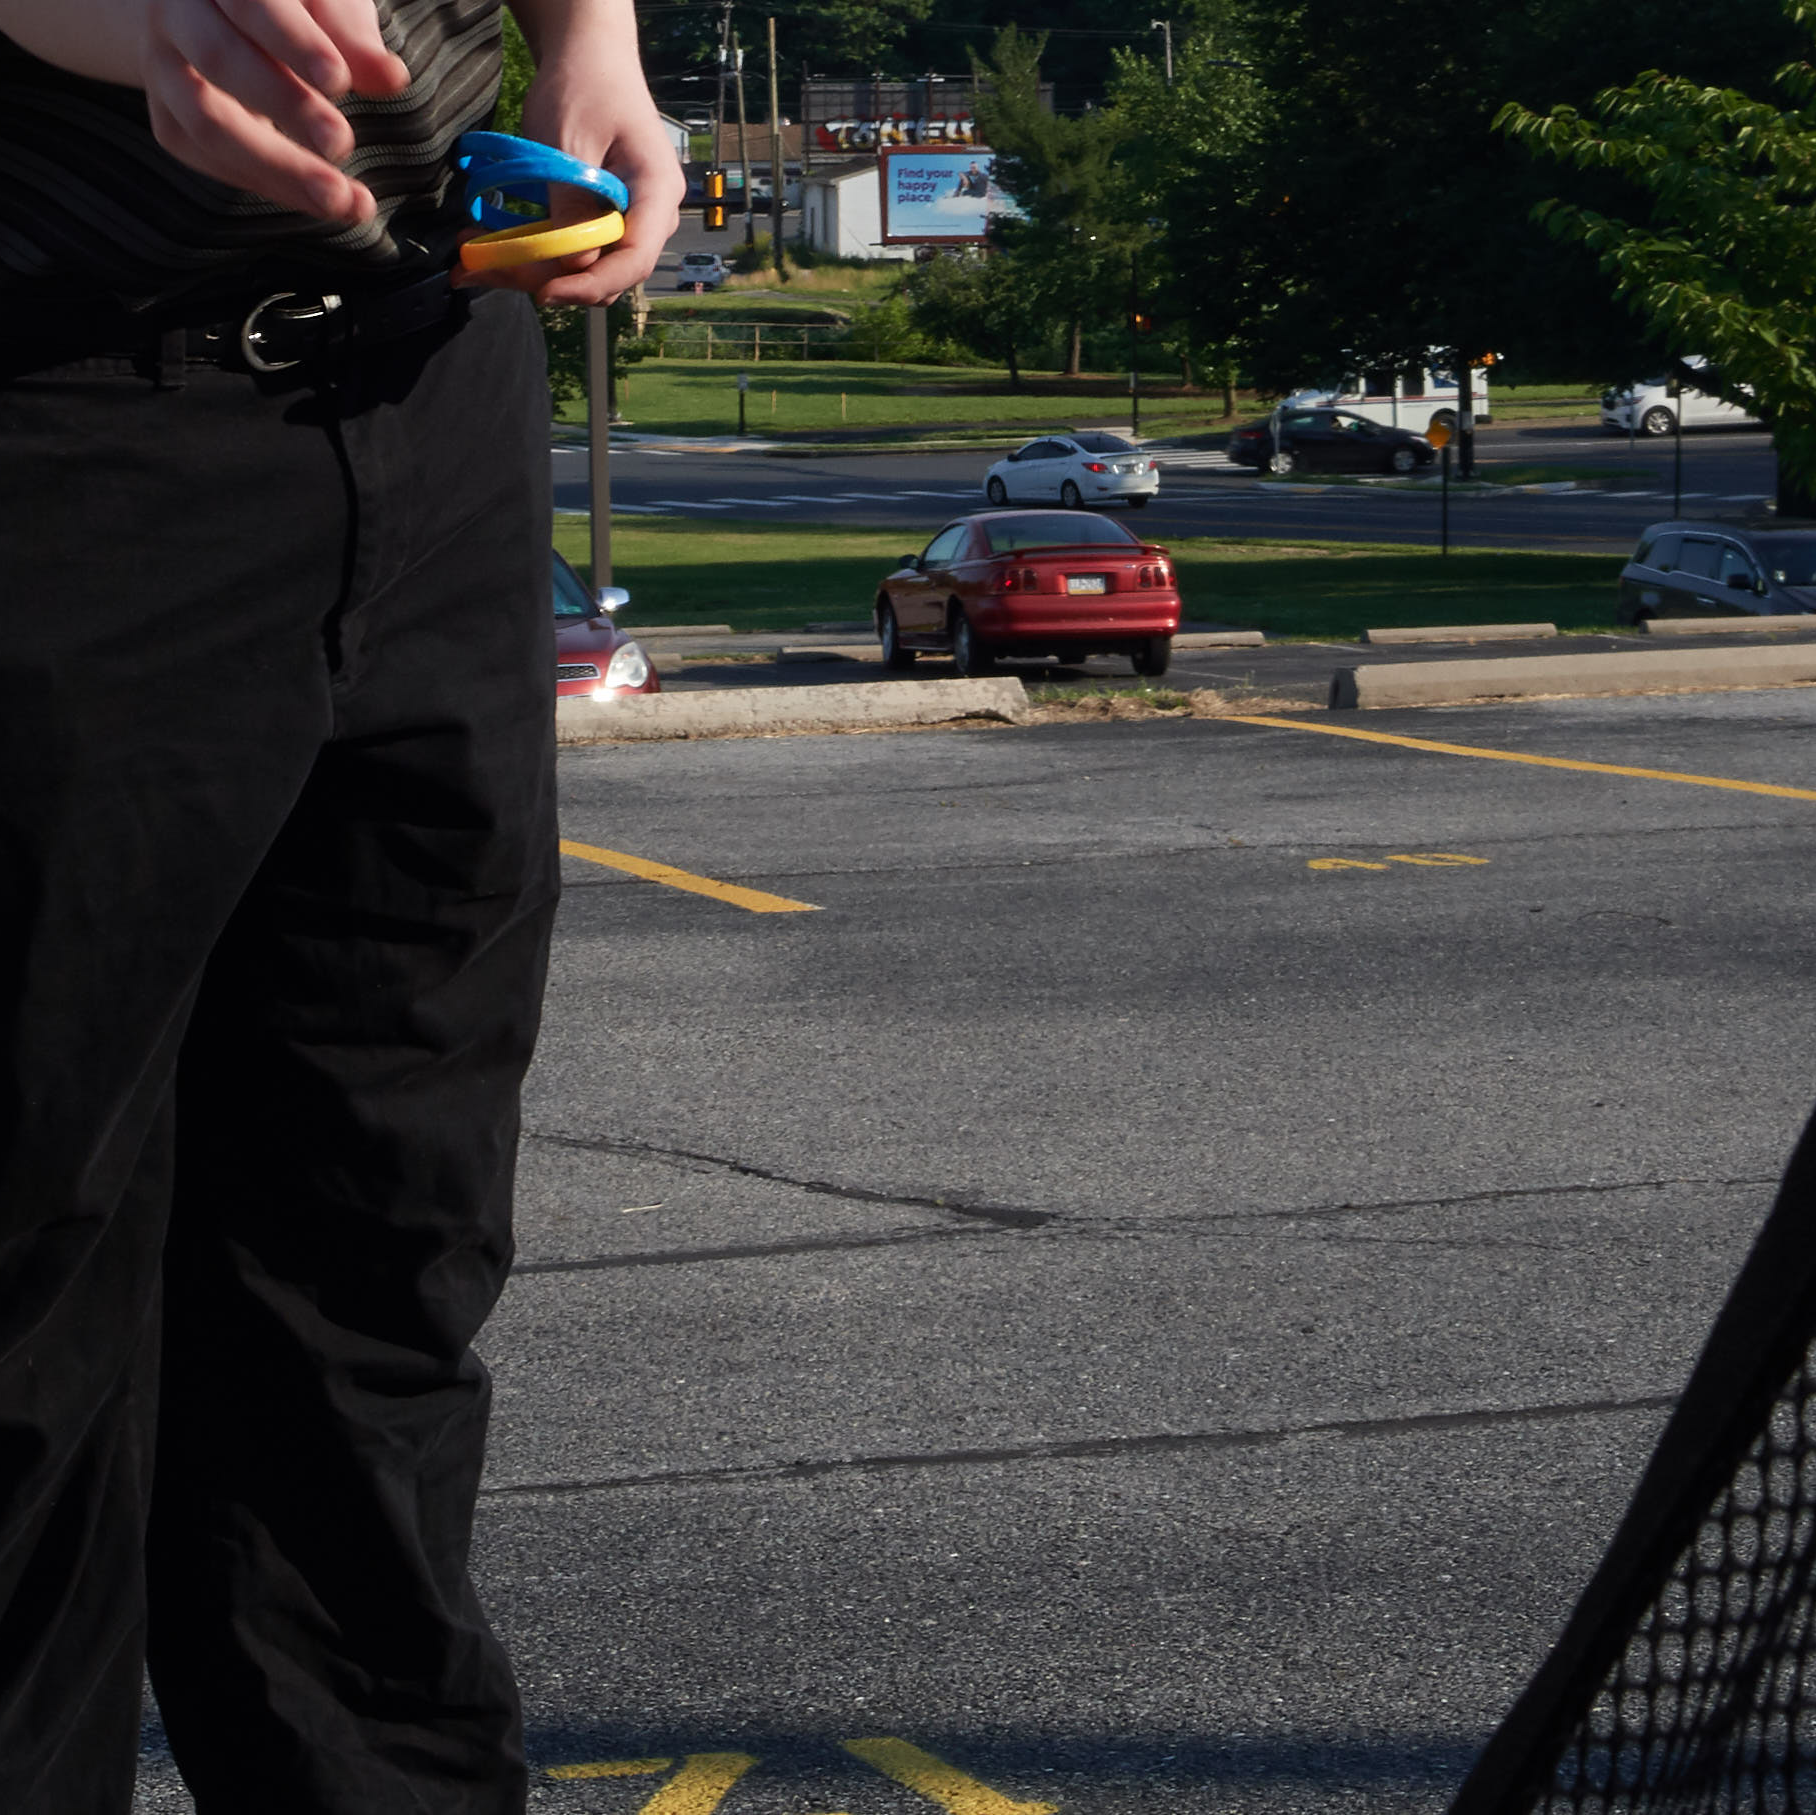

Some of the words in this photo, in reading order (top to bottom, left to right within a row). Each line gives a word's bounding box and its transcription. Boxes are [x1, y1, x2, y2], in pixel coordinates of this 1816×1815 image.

[897, 168, 924, 178] Find
[926, 170, 953, 180] your
[897, 180, 937, 192] happy
[897, 192, 934, 204] place.
